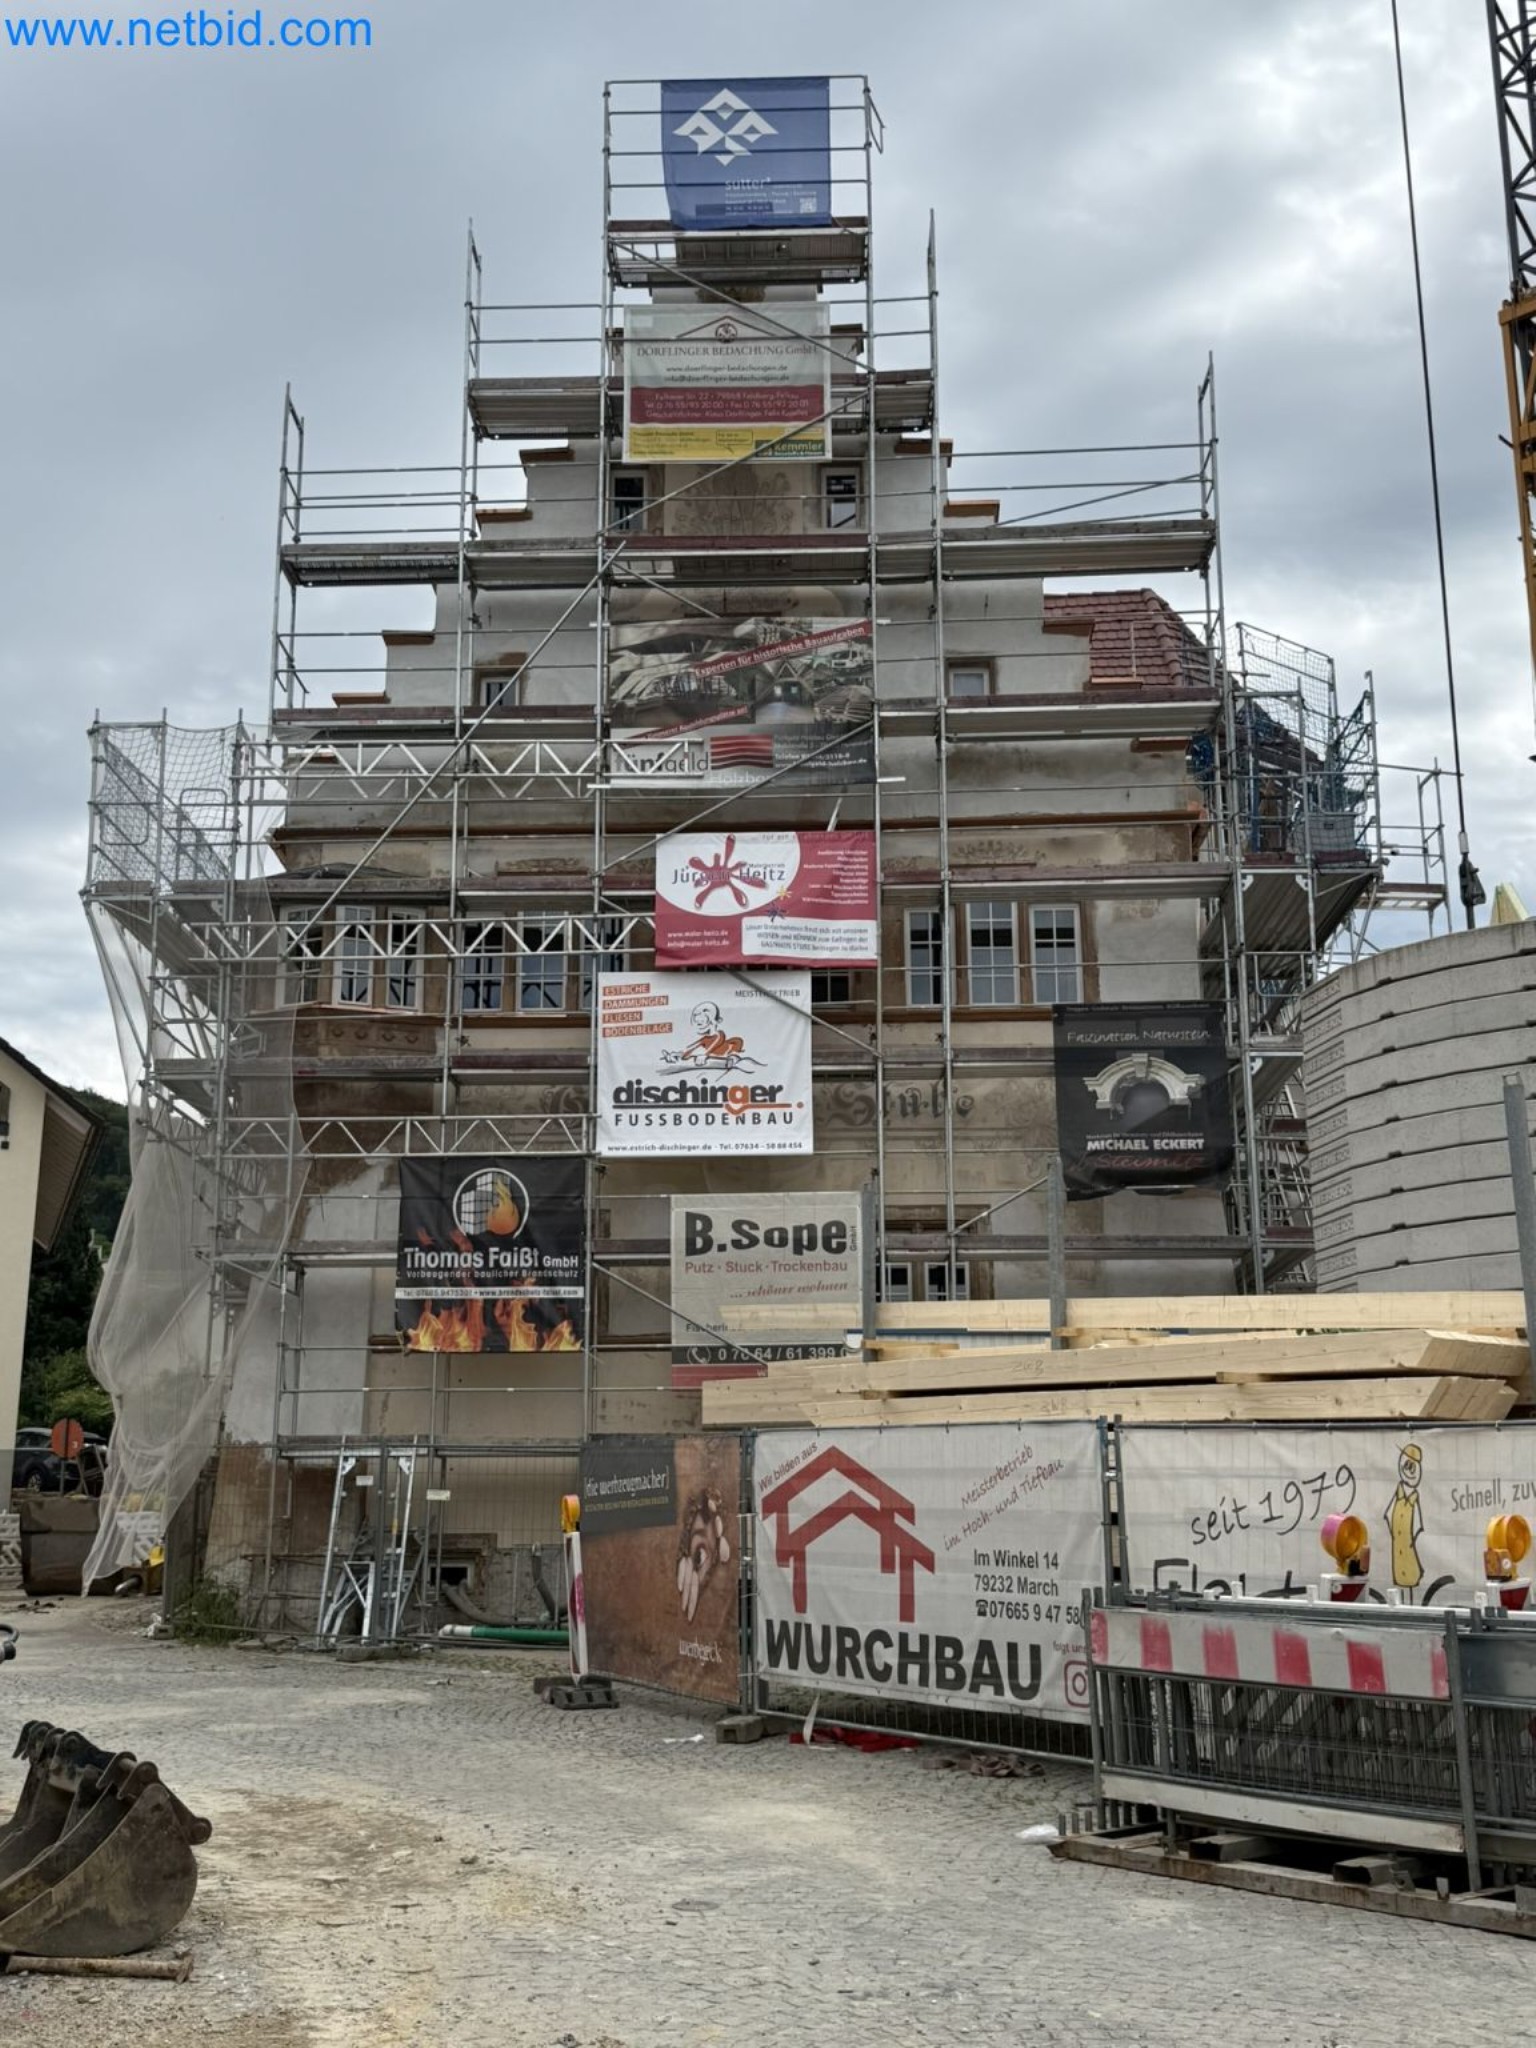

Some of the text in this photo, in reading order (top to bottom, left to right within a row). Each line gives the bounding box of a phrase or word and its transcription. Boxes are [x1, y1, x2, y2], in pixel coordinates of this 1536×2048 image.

[712, 344, 783, 356] BEDACHUNG
[695, 626, 865, 678] Experten für historische Bauaufgaben
[739, 866, 786, 882] Heitz
[604, 984, 649, 996] ESTRICHE
[604, 1011, 641, 1023] FLIESEN
[1143, 1029, 1211, 1042] Naturstein
[612, 1078, 784, 1111] dischinger
[615, 1111, 794, 1127] FUSSBODENBAU
[607, 1143, 712, 1153] www.estrich-dischinger.de
[1086, 1138, 1205, 1151] MICHAEL ECKERT
[684, 1211, 848, 1257] B.Sope
[404, 1247, 484, 1269] Thomas
[542, 1256, 579, 1268] GmbH
[685, 1260, 848, 1275] Putz Stuck Trockenbau
[407, 1269, 579, 1280] Vorbeugender baulicher Brandschutz
[797, 1280, 848, 1294] wohnen
[718, 1348, 728, 1361] 0
[755, 1347, 772, 1360] 64
[786, 1347, 803, 1359] 61
[809, 1347, 836, 1359] 399
[758, 1442, 818, 1492] Wir bilden aus
[961, 1444, 1034, 1509] Meisterbetrieb
[943, 1458, 1065, 1552] im Hoch- und Tiefbau
[1191, 1463, 1357, 1546] seit 1979
[1451, 1478, 1506, 1513] Schnell,
[974, 1549, 1059, 1570] Im Winkel 14
[974, 1574, 1058, 1596] 79232 March
[989, 1600, 1030, 1621] 07665
[1033, 1603, 1041, 1622] 9
[1045, 1605, 1061, 1624] 47
[766, 1618, 1043, 1702] WURCHBAU
